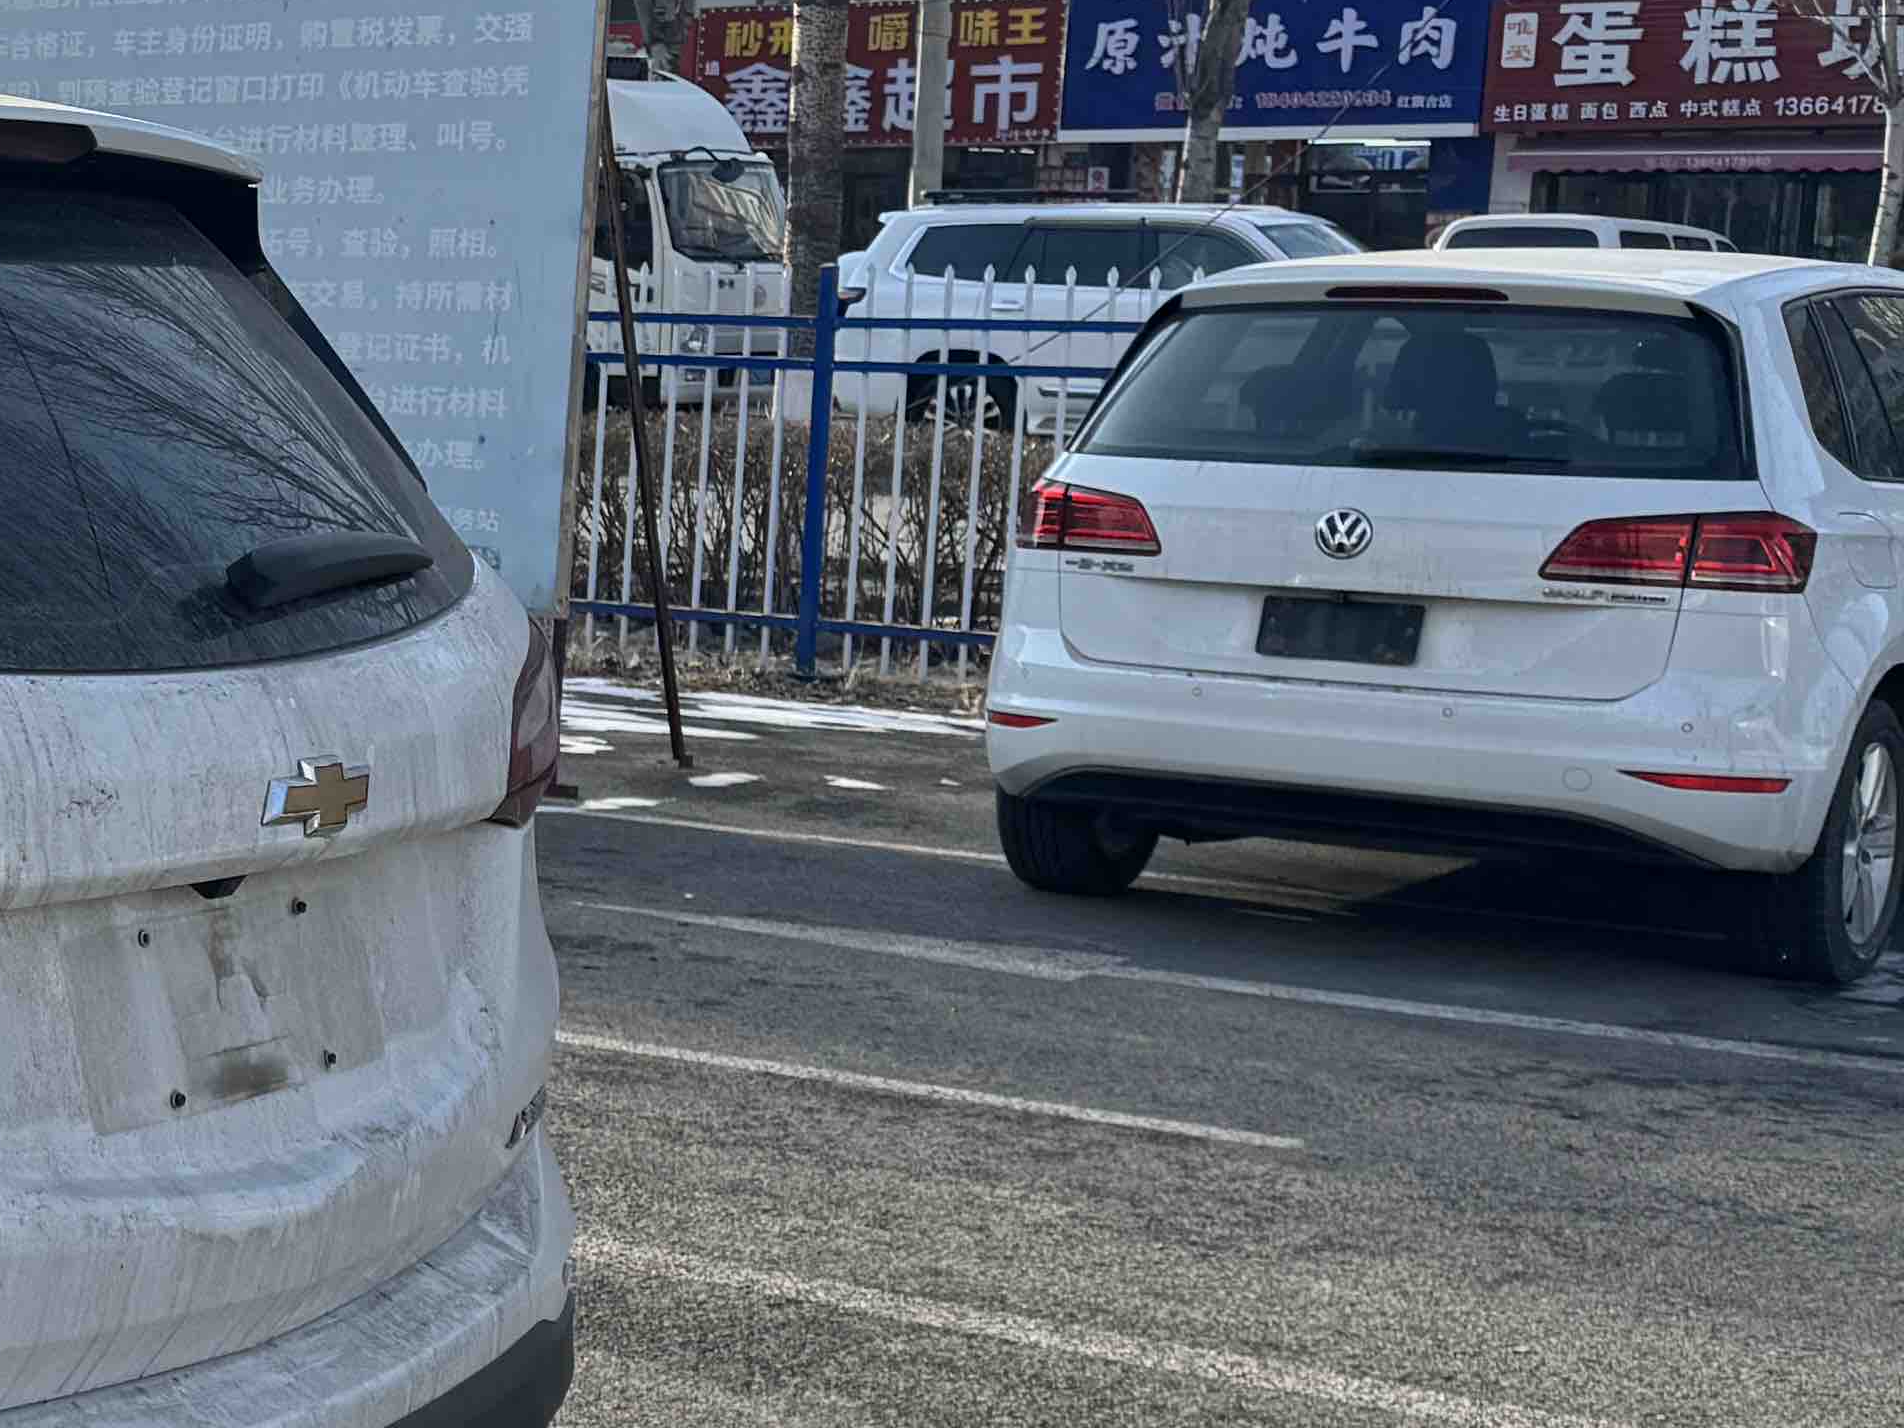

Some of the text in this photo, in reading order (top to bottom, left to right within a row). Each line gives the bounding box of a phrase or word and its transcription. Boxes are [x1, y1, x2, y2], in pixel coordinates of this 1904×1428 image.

[1085, 6, 1458, 75] 原汁炖牛肉
[1493, 101, 1570, 122] 生日蛋糕
[1580, 101, 1619, 120] 面包
[1629, 100, 1670, 119] 西点
[1679, 98, 1762, 119] 中式糕点
